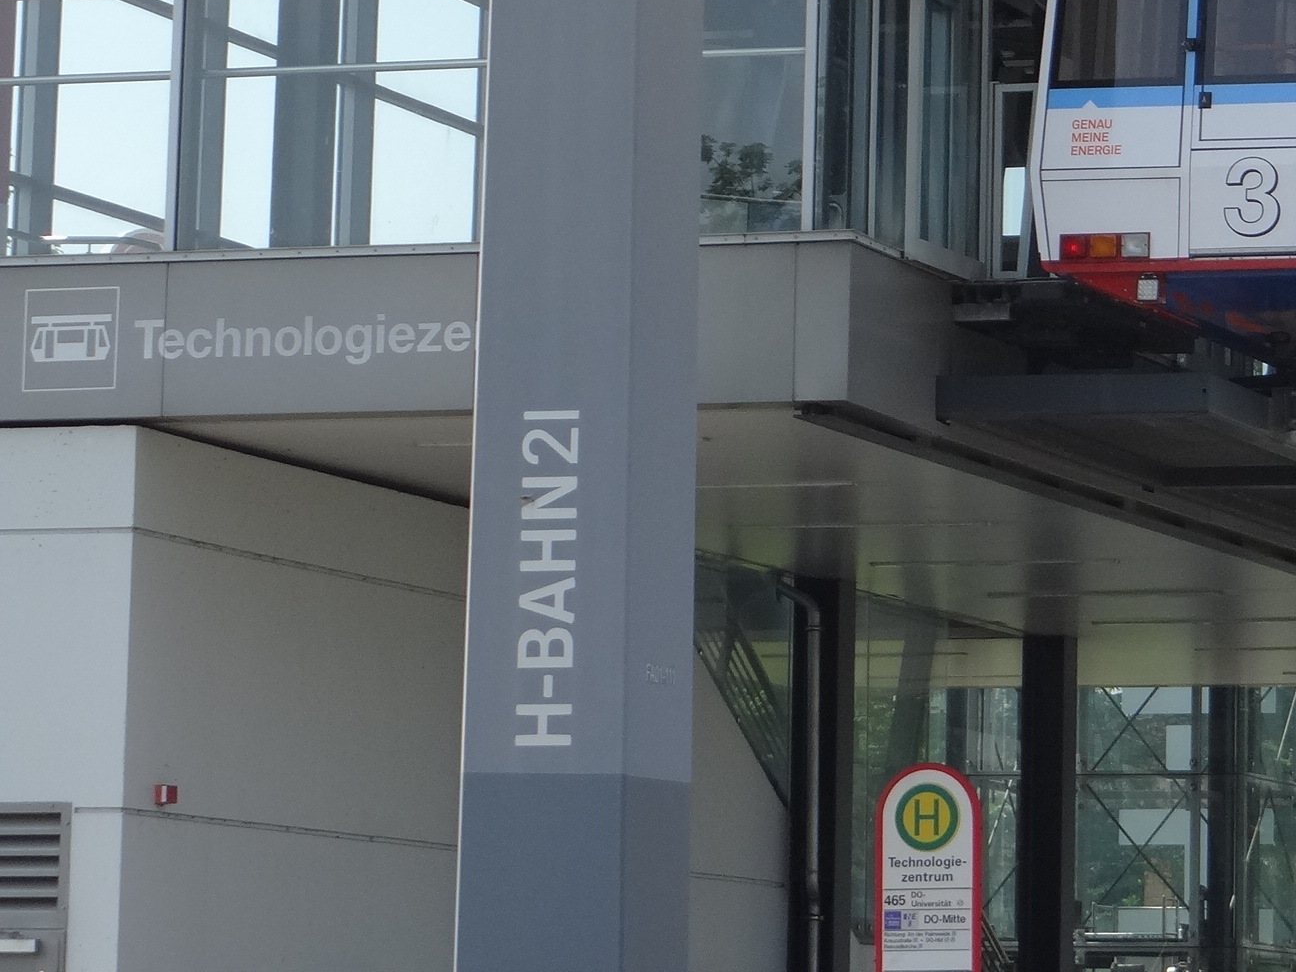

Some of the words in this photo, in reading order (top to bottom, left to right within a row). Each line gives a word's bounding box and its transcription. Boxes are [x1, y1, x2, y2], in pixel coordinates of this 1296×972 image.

[1071, 118, 1113, 130] GENAU
[1070, 131, 1110, 143] MEINE
[1070, 144, 1123, 156] ENERGIE
[1223, 156, 1281, 237] 3
[134, 314, 472, 366] Technologieze
[914, 798, 940, 836] H
[888, 856, 967, 870] Technologie-
[901, 872, 954, 883] zentrum
[884, 894, 906, 906] 465
[924, 914, 966, 924] DO-Mitte
